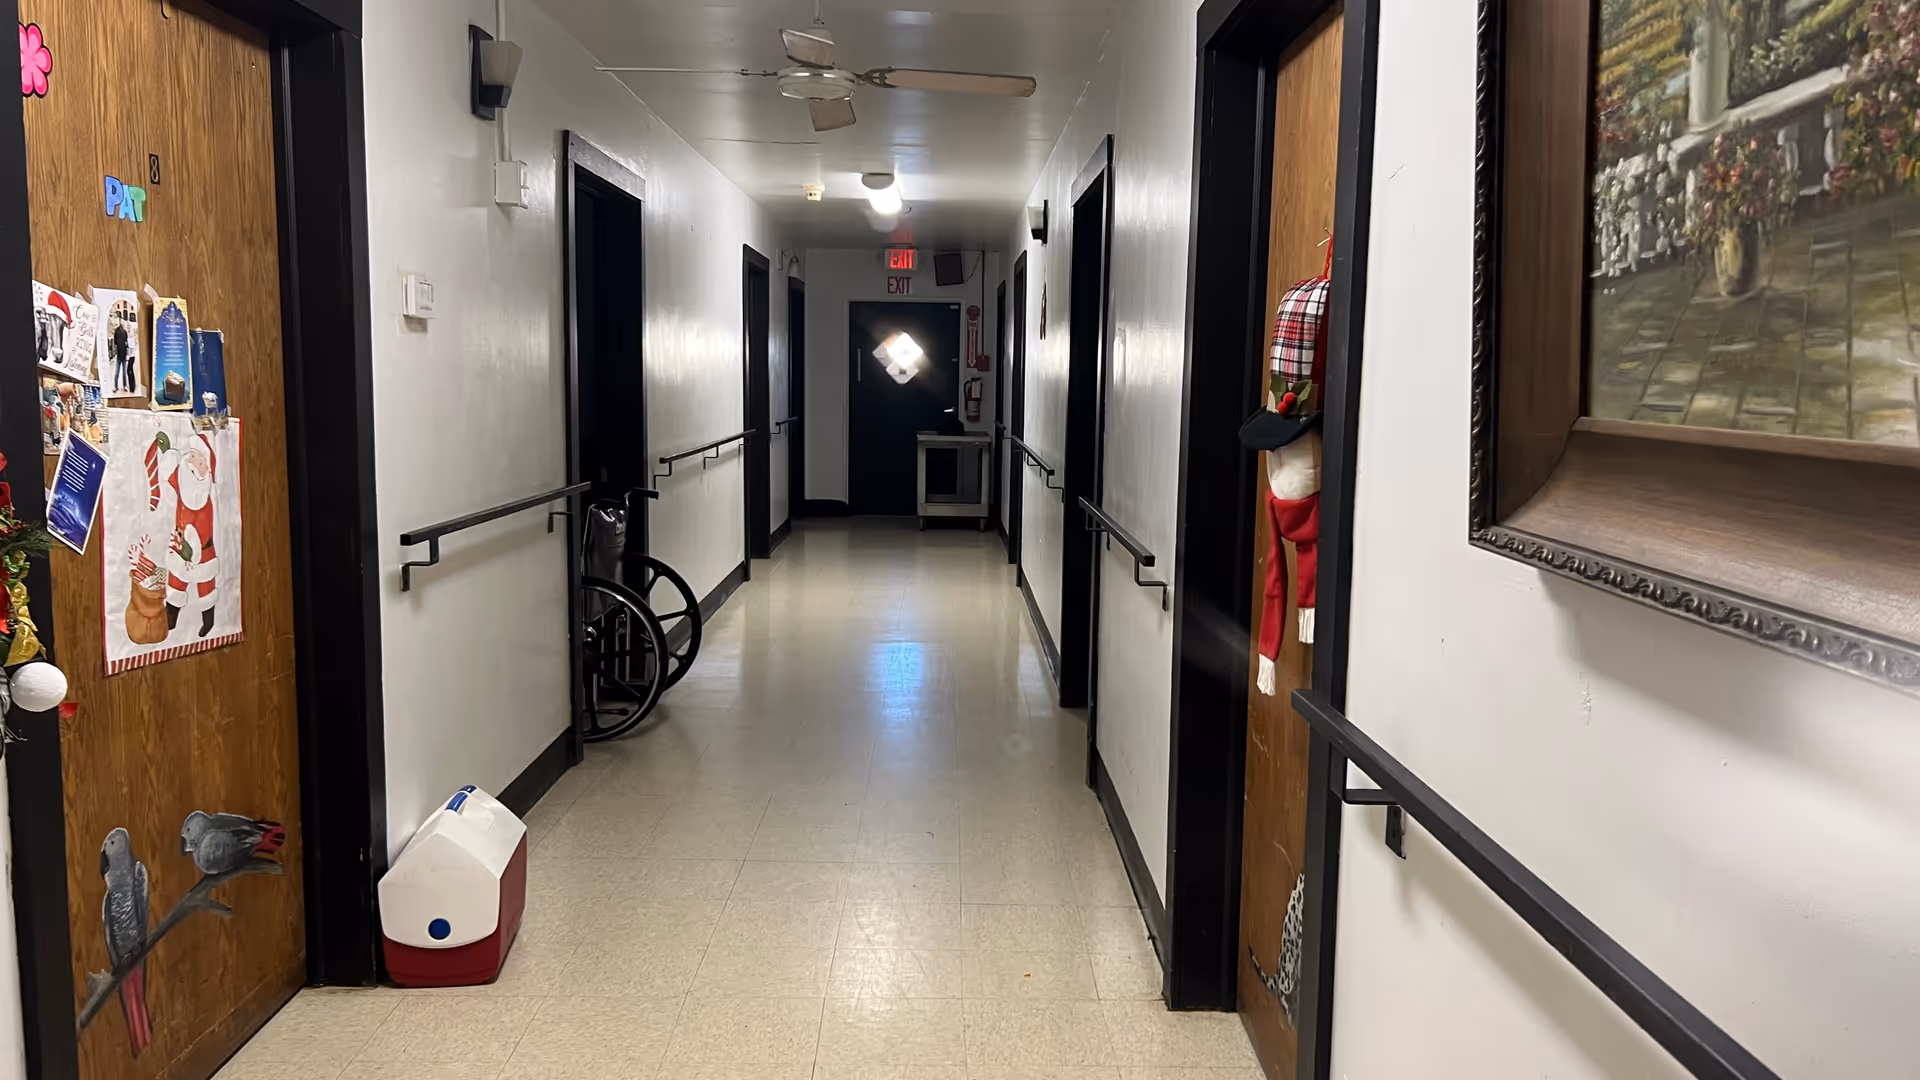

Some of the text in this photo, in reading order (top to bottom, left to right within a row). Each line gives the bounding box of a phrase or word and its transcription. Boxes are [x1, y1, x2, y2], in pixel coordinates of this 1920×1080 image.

[150, 156, 159, 183] 8
[104, 175, 147, 222] PAT
[889, 248, 913, 268] EXIT
[887, 276, 912, 294] EXIT
